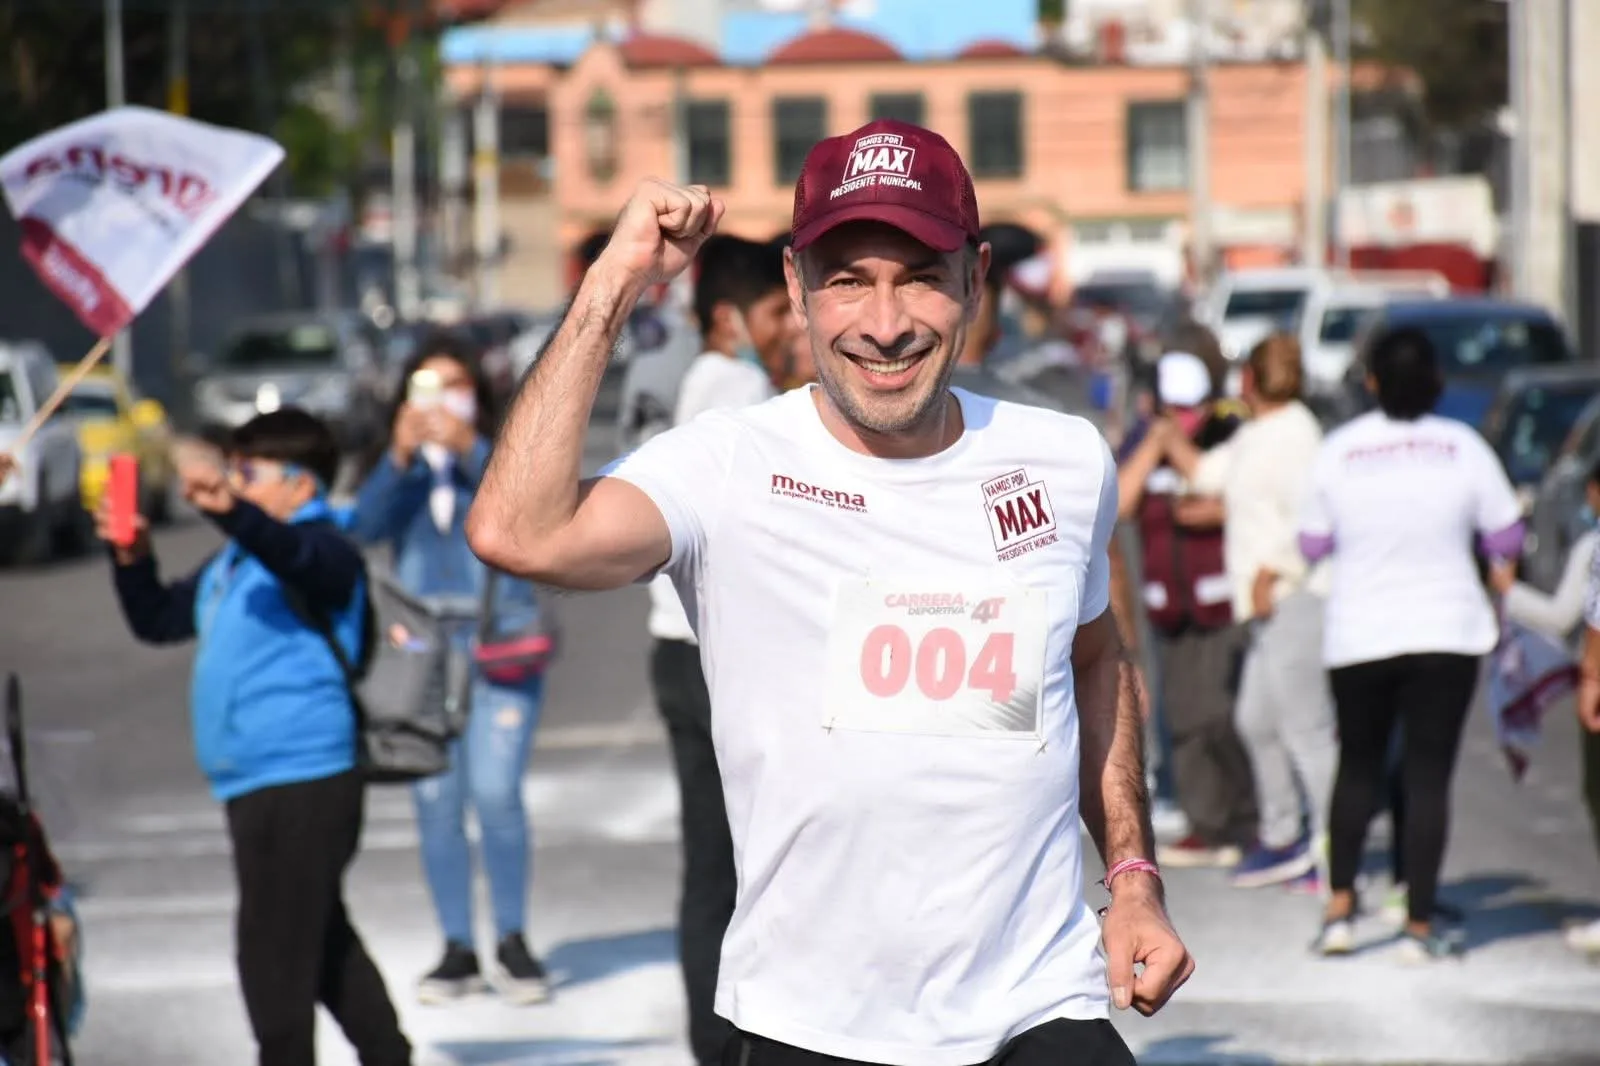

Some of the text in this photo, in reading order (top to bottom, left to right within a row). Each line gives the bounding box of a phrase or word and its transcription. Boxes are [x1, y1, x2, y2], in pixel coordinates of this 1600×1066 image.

[858, 135, 899, 148] VAMOS POR
[851, 147, 909, 176] MAX
[829, 175, 922, 201] PRESIDENTE MUNICIPAL
[771, 473, 867, 508] morena
[985, 473, 1026, 497] VAMOS POR
[783, 489, 823, 505] esperanza
[825, 500, 835, 508] de
[994, 488, 1050, 542] MAX
[998, 541, 1034, 562] PRESIDENTE
[884, 592, 964, 608] CARRERA
[907, 605, 965, 616] DEPORTIVA
[970, 596, 1006, 624] 4T
[860, 624, 1017, 704] 004
